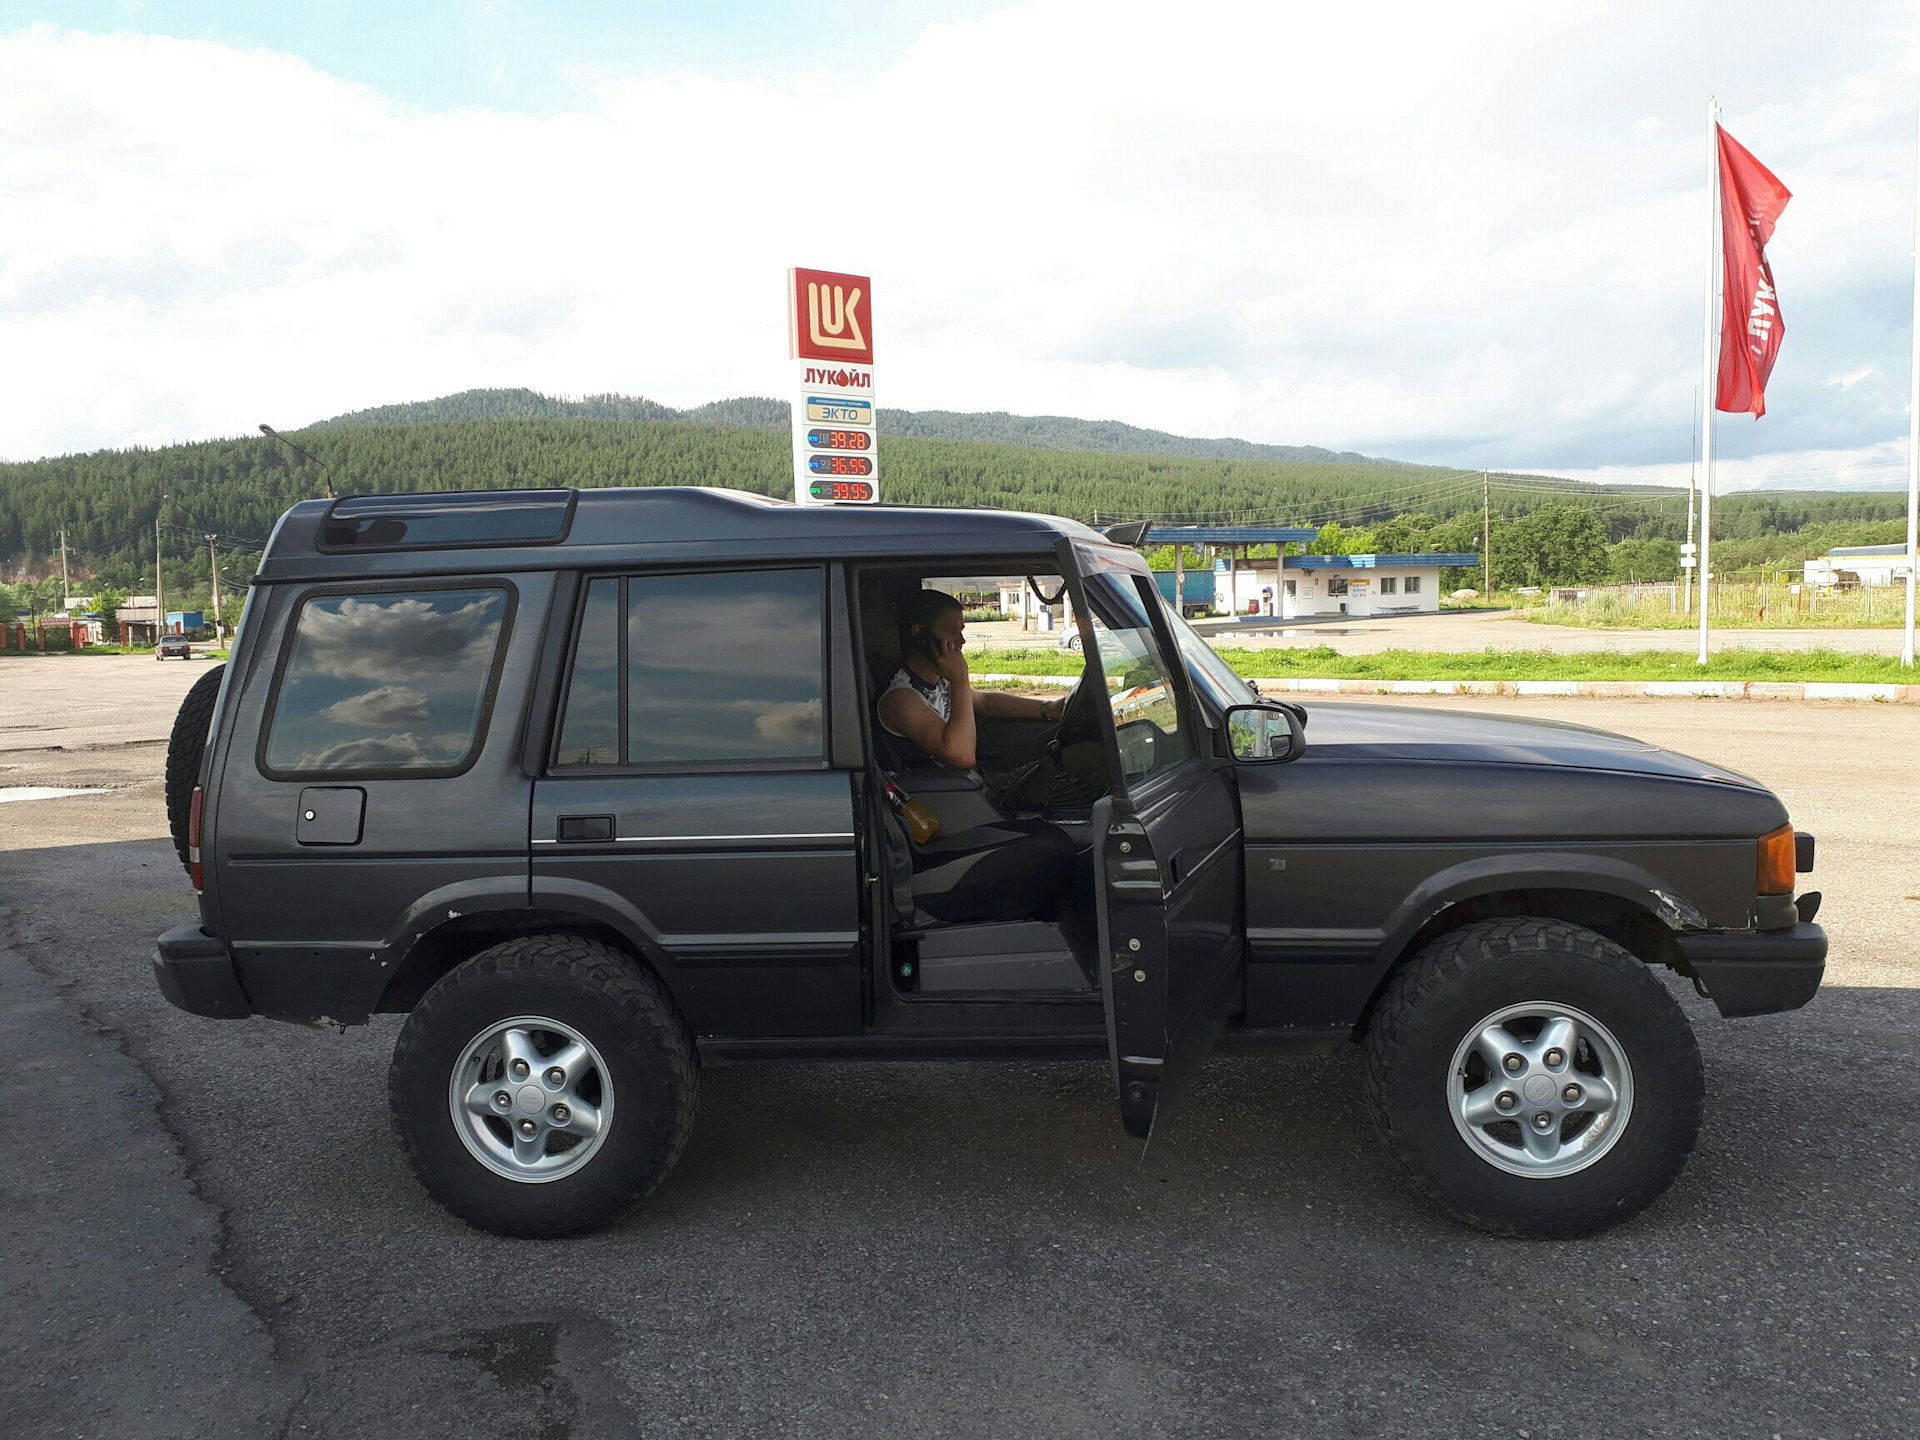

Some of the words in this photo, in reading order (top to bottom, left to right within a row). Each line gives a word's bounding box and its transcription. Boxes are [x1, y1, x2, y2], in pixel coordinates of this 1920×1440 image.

[804, 368, 870, 387] ЛУКОЙЛ
[822, 407, 858, 421] ЭКТО
[831, 432, 865, 448] 39.28
[820, 459, 831, 470] 92
[831, 457, 866, 475] 36.95
[821, 484, 833, 495] 95
[833, 482, 868, 500] 39.95
